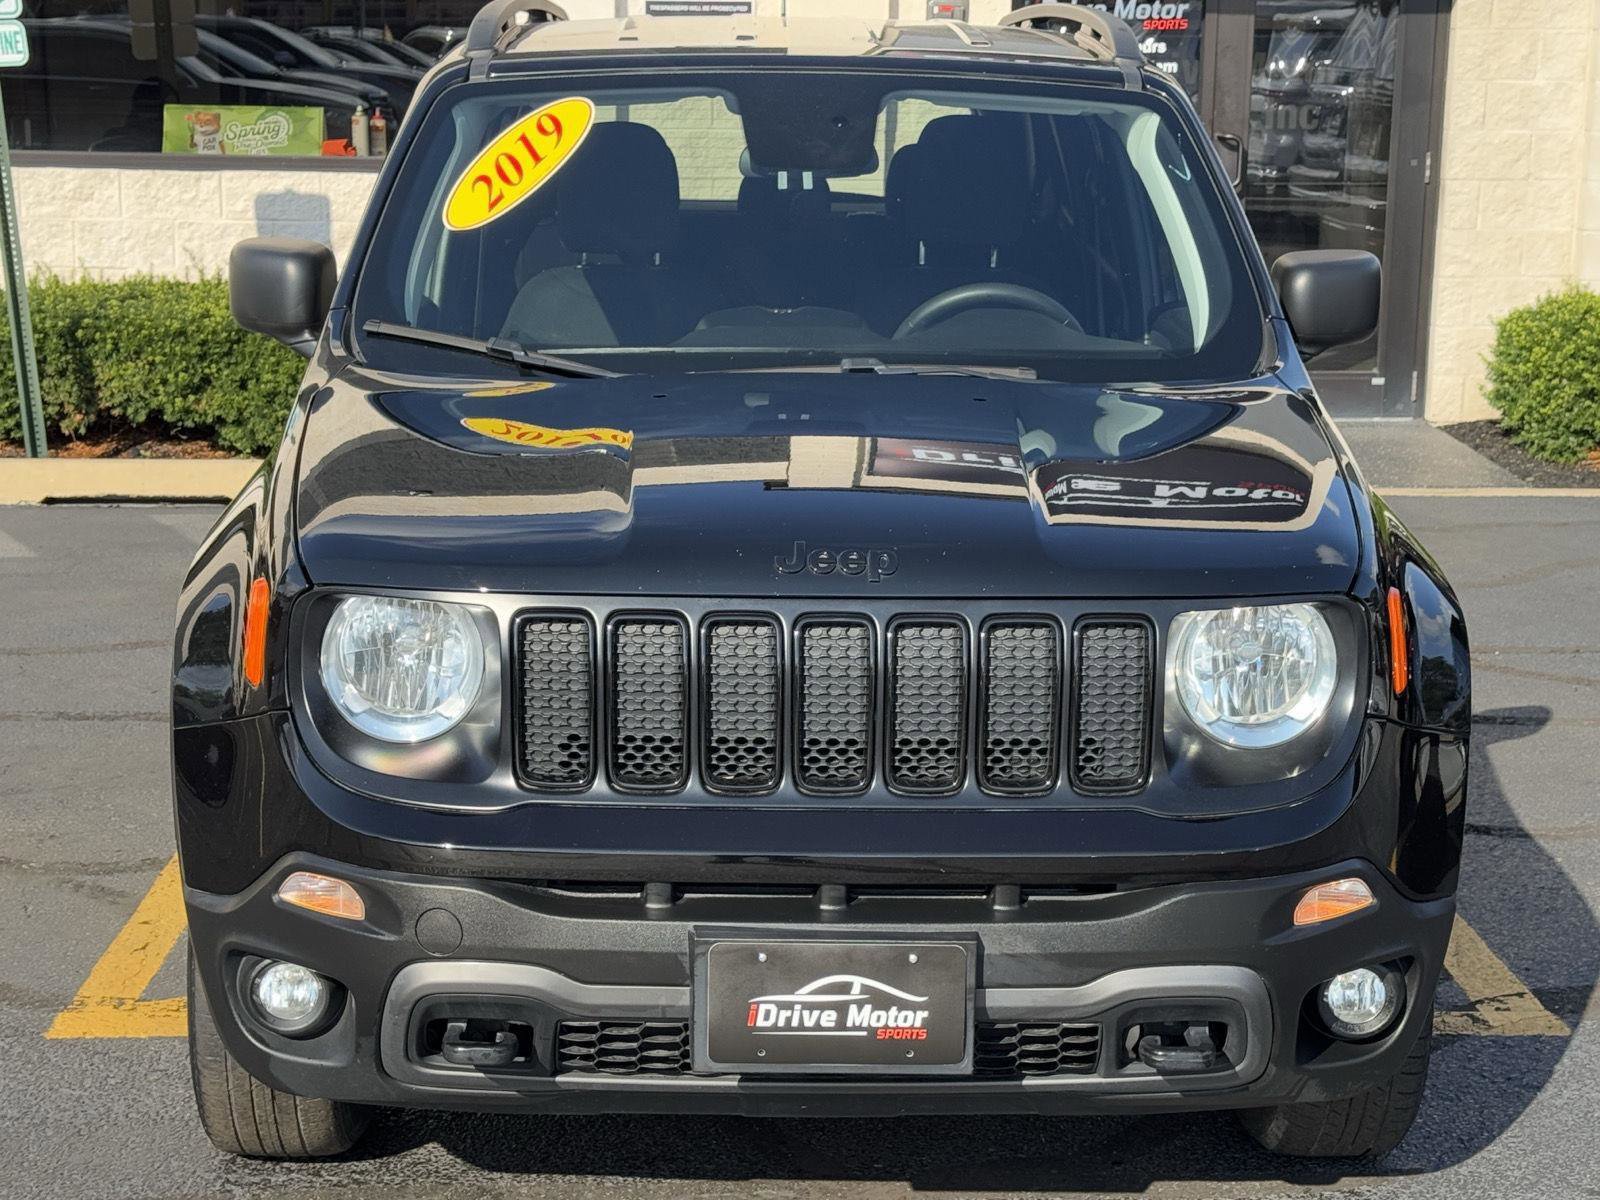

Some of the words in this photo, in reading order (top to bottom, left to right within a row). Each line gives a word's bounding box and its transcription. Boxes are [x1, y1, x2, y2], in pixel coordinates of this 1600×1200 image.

[1114, 0, 1189, 19] Motor
[1143, 19, 1188, 30] SPORTS
[226, 122, 282, 140] Spring
[471, 113, 563, 212] 2019
[774, 540, 900, 583] Jeep
[747, 1002, 838, 1028] iDrive
[846, 1004, 929, 1028] Motor
[876, 1028, 928, 1040] SPORTS
